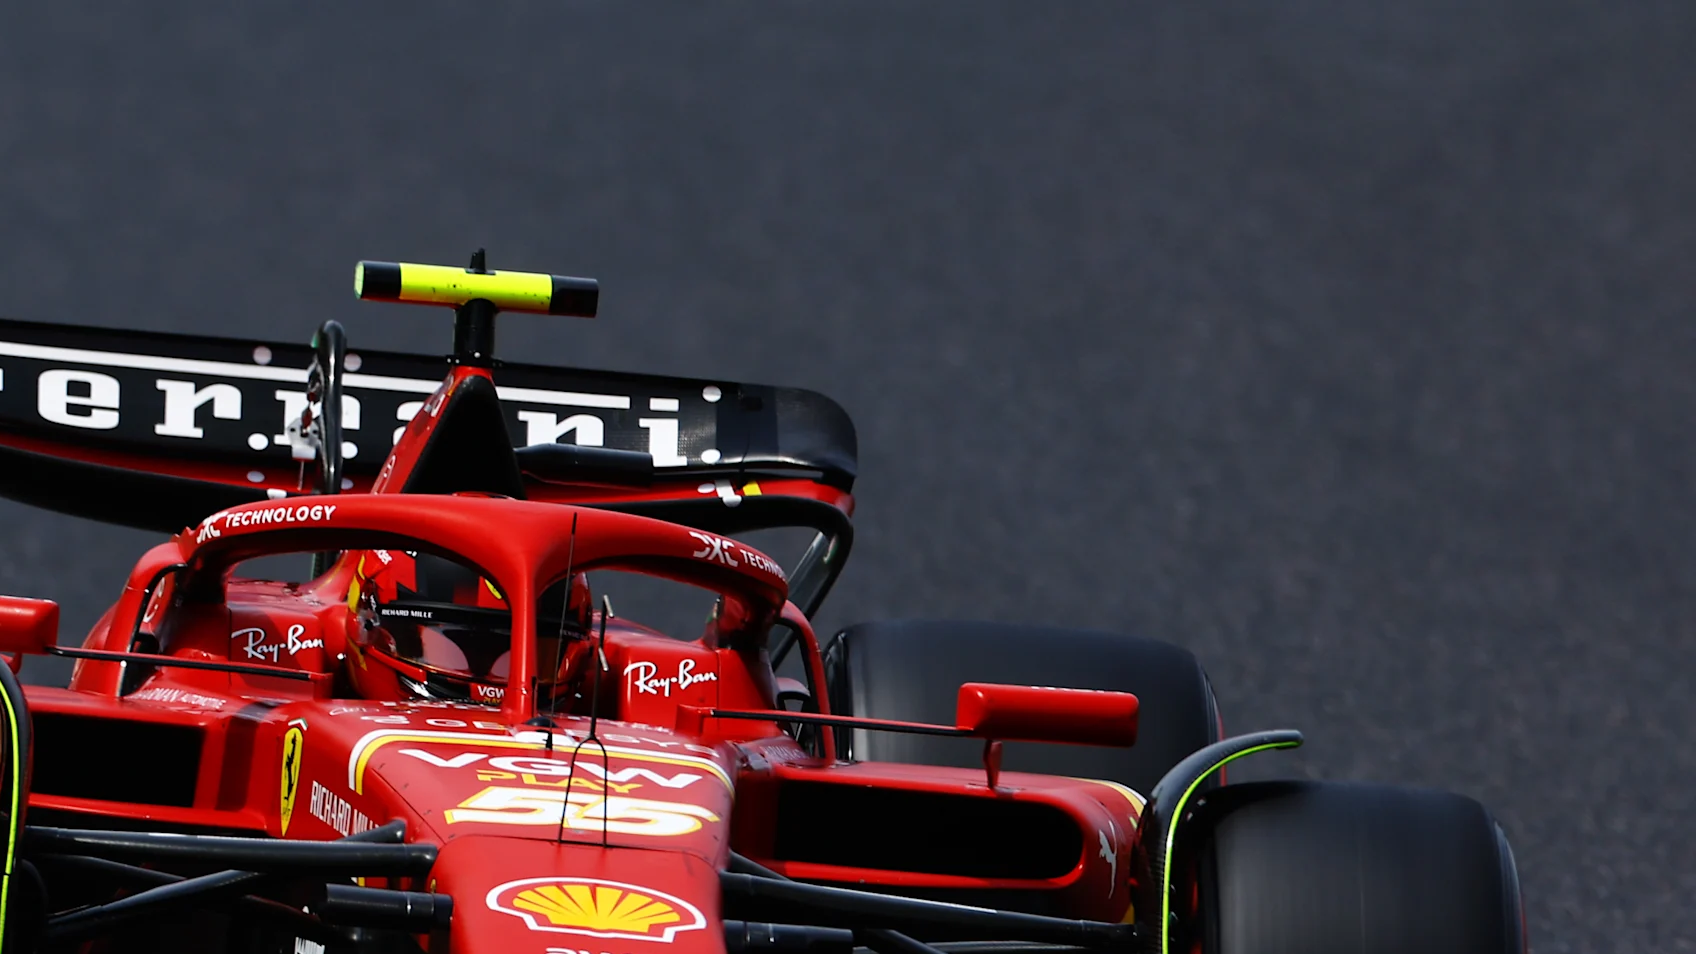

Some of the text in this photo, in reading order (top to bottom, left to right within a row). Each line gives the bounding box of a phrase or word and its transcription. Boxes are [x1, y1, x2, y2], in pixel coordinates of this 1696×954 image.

[225, 505, 336, 528] TECHNOLOGY
[411, 610, 433, 618] MILLE
[231, 624, 324, 662] Ray-Ban
[398, 748, 703, 788] VGW
[477, 769, 643, 794] PLAY
[310, 780, 352, 838] RICHARD
[444, 786, 720, 836] 55
